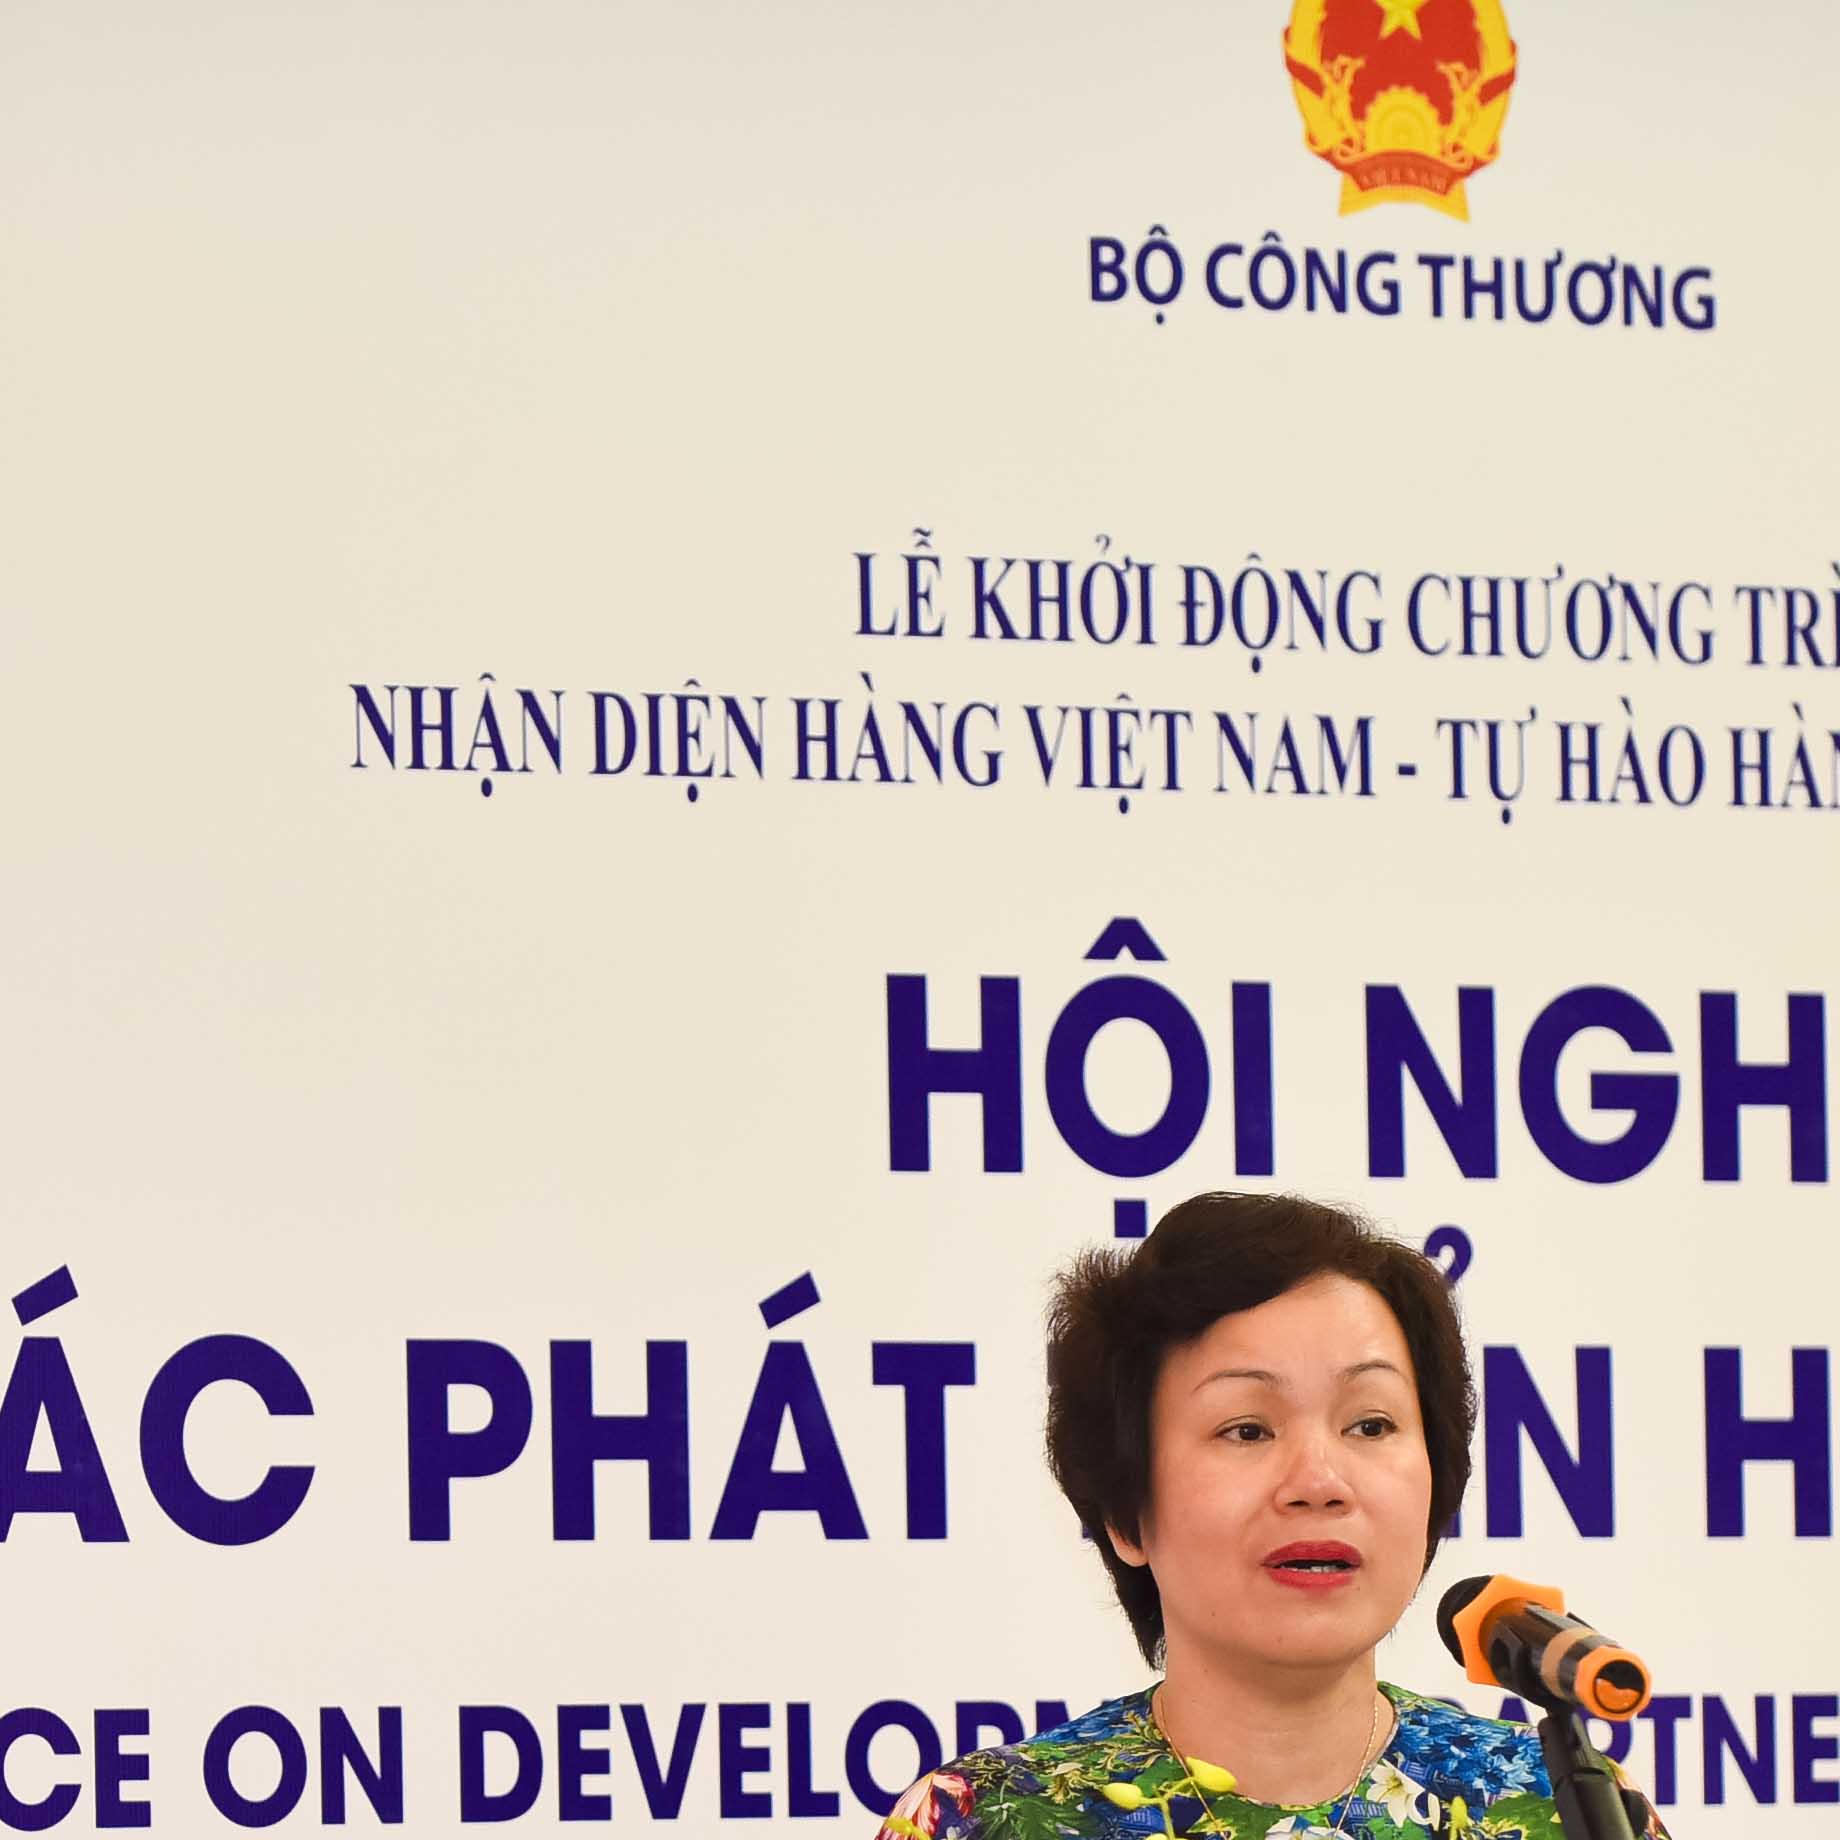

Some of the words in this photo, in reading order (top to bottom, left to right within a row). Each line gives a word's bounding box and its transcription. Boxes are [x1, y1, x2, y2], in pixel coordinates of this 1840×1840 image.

[1090, 225, 1183, 324] BỘ
[1206, 232, 1400, 316] CÔNG
[1418, 250, 1715, 330] THƯƠNG
[855, 528, 943, 637] LỄ
[970, 536, 1155, 644] KHỞI
[1180, 554, 1382, 673] ĐỘNG
[1408, 566, 1712, 664] CHƯƠNG
[350, 673, 563, 797] NHẬN
[589, 679, 766, 802] DIỆN
[792, 672, 1001, 786] HÀNG
[1024, 694, 1191, 814] VIỆT
[1215, 712, 1374, 796] NAM
[1398, 765, 1416, 776] -
[1437, 708, 1536, 824] TỰ
[1558, 697, 1705, 806] HÀO
[886, 917, 1274, 1239] HỘI
[406, 1272, 976, 1541] PHÁT
[203, 1705, 403, 1828] ON
[460, 1699, 1118, 1824] DEVELOP
